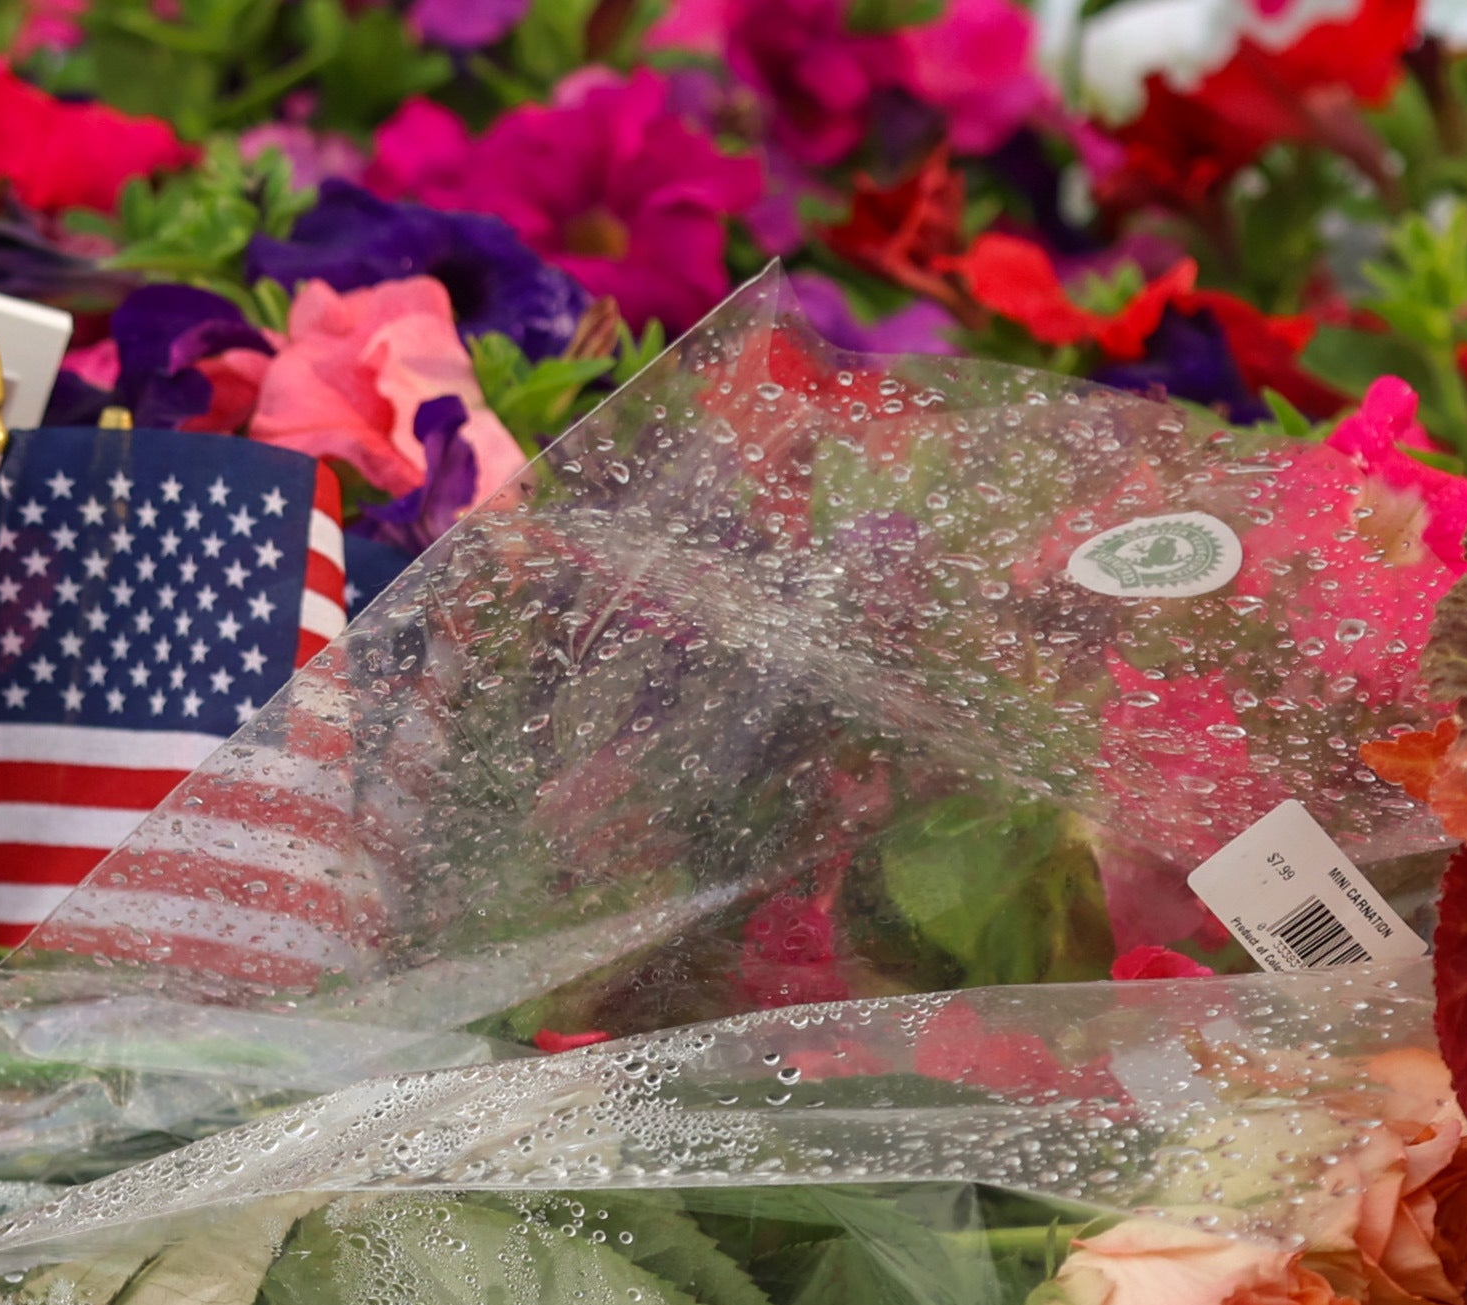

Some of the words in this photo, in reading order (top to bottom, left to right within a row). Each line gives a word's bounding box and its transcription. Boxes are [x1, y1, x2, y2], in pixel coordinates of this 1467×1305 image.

[1265, 851, 1296, 882] $7.99
[1327, 866, 1351, 892] MINI
[1346, 887, 1395, 939] CARNATION
[1230, 915, 1260, 949] Product
[1255, 940, 1270, 954] of
